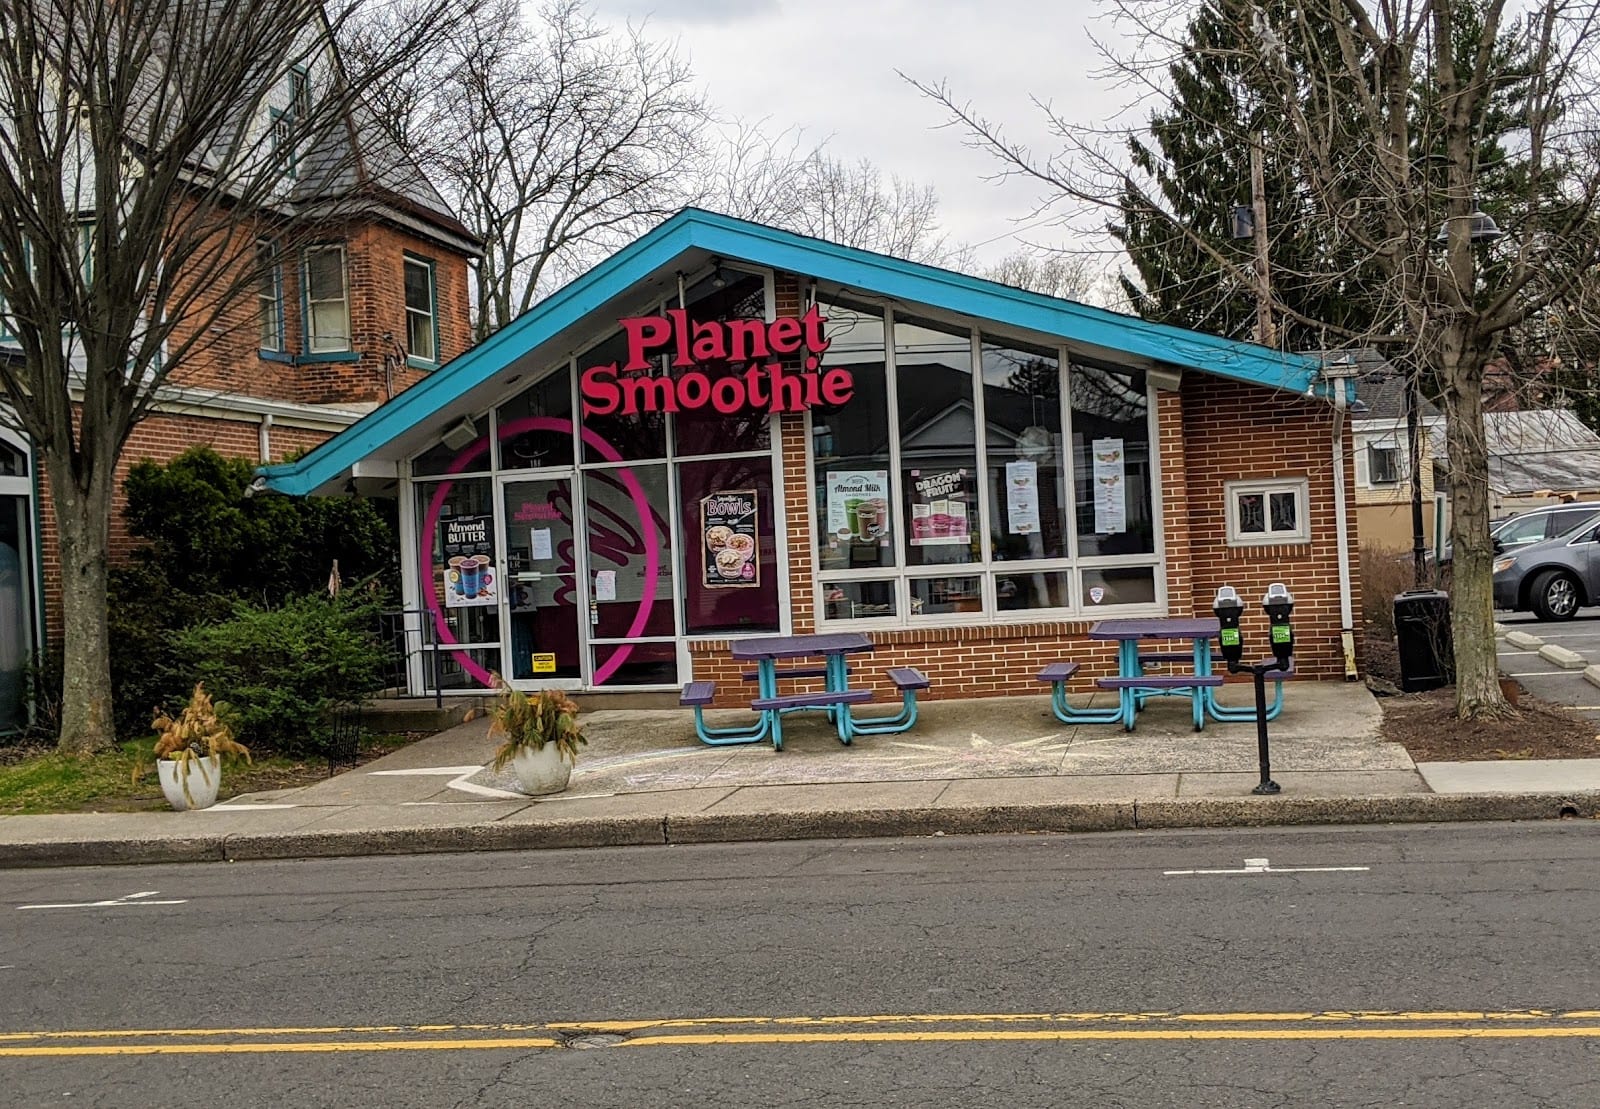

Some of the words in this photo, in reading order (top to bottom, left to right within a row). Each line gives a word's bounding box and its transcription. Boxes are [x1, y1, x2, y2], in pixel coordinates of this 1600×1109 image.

[617, 303, 831, 371] Planet
[580, 356, 855, 419] Smoothie
[834, 484, 863, 493] Almond
[865, 484, 881, 493] Milk
[915, 472, 961, 491] DRAGON
[926, 483, 954, 497] FRUIT
[707, 498, 752, 516] Bowls
[448, 520, 485, 532] Almond
[448, 531, 486, 543] BUTTER
